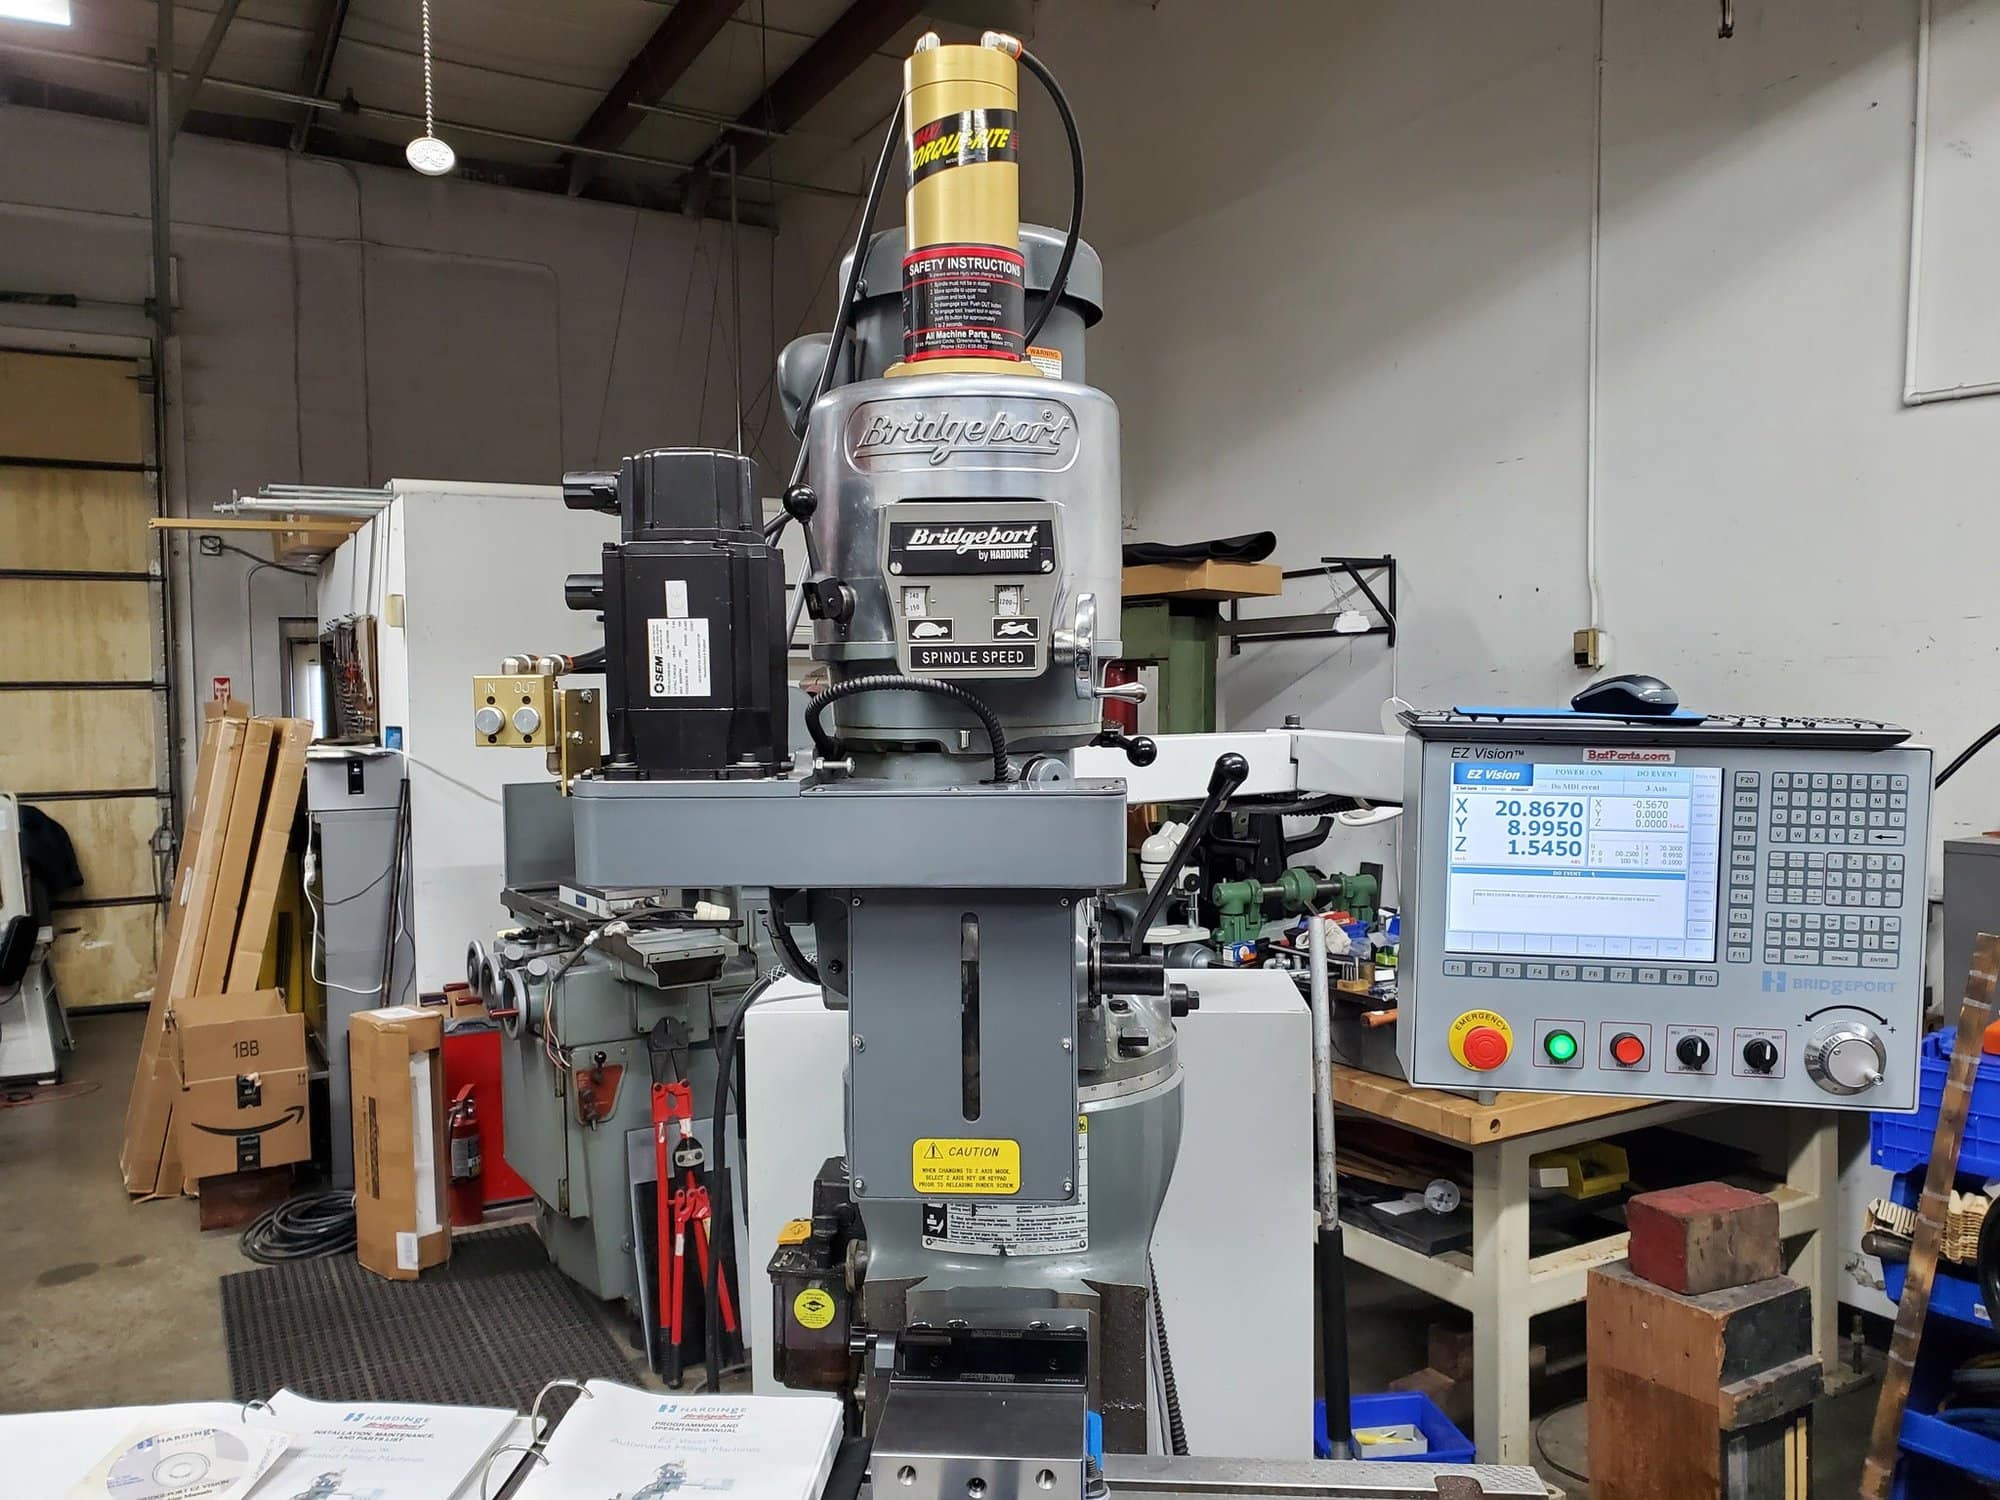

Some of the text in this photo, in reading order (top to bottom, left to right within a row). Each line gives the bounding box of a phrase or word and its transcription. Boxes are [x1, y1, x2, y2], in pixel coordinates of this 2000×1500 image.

[909, 256, 1021, 277] SAFETY INSTRUCTIONS
[926, 329, 1003, 340] All Machine Parts, Inc.
[1030, 348, 1059, 359] WARNING
[857, 410, 1071, 465] Bridgeport
[906, 525, 1038, 555] Bridgeport
[978, 549, 1028, 561] by HARDINGE
[922, 651, 1024, 664] SPINDLE SPEED
[654, 655, 664, 682] SEM
[482, 680, 496, 694] IN
[1451, 747, 1470, 759] EZ
[1587, 749, 1671, 761] BptParts.com
[1467, 769, 1520, 780] EZ Vision
[1555, 768, 1586, 776] POWER
[1455, 798, 1583, 818] X 20.8670
[1595, 800, 1669, 809] X -0.5670
[1595, 809, 1668, 819] Y 0.0000
[1455, 817, 1582, 837] Y 8.9950
[1595, 818, 1601, 827] Z
[1635, 819, 1668, 829] 0.0000
[1455, 836, 1581, 857] Z 1.5450
[1455, 1012, 1509, 1031] EMERGENCY
[232, 1039, 260, 1059] 1BB
[948, 1146, 1000, 1158] CAUTION
[610, 1437, 672, 1450] Automated
